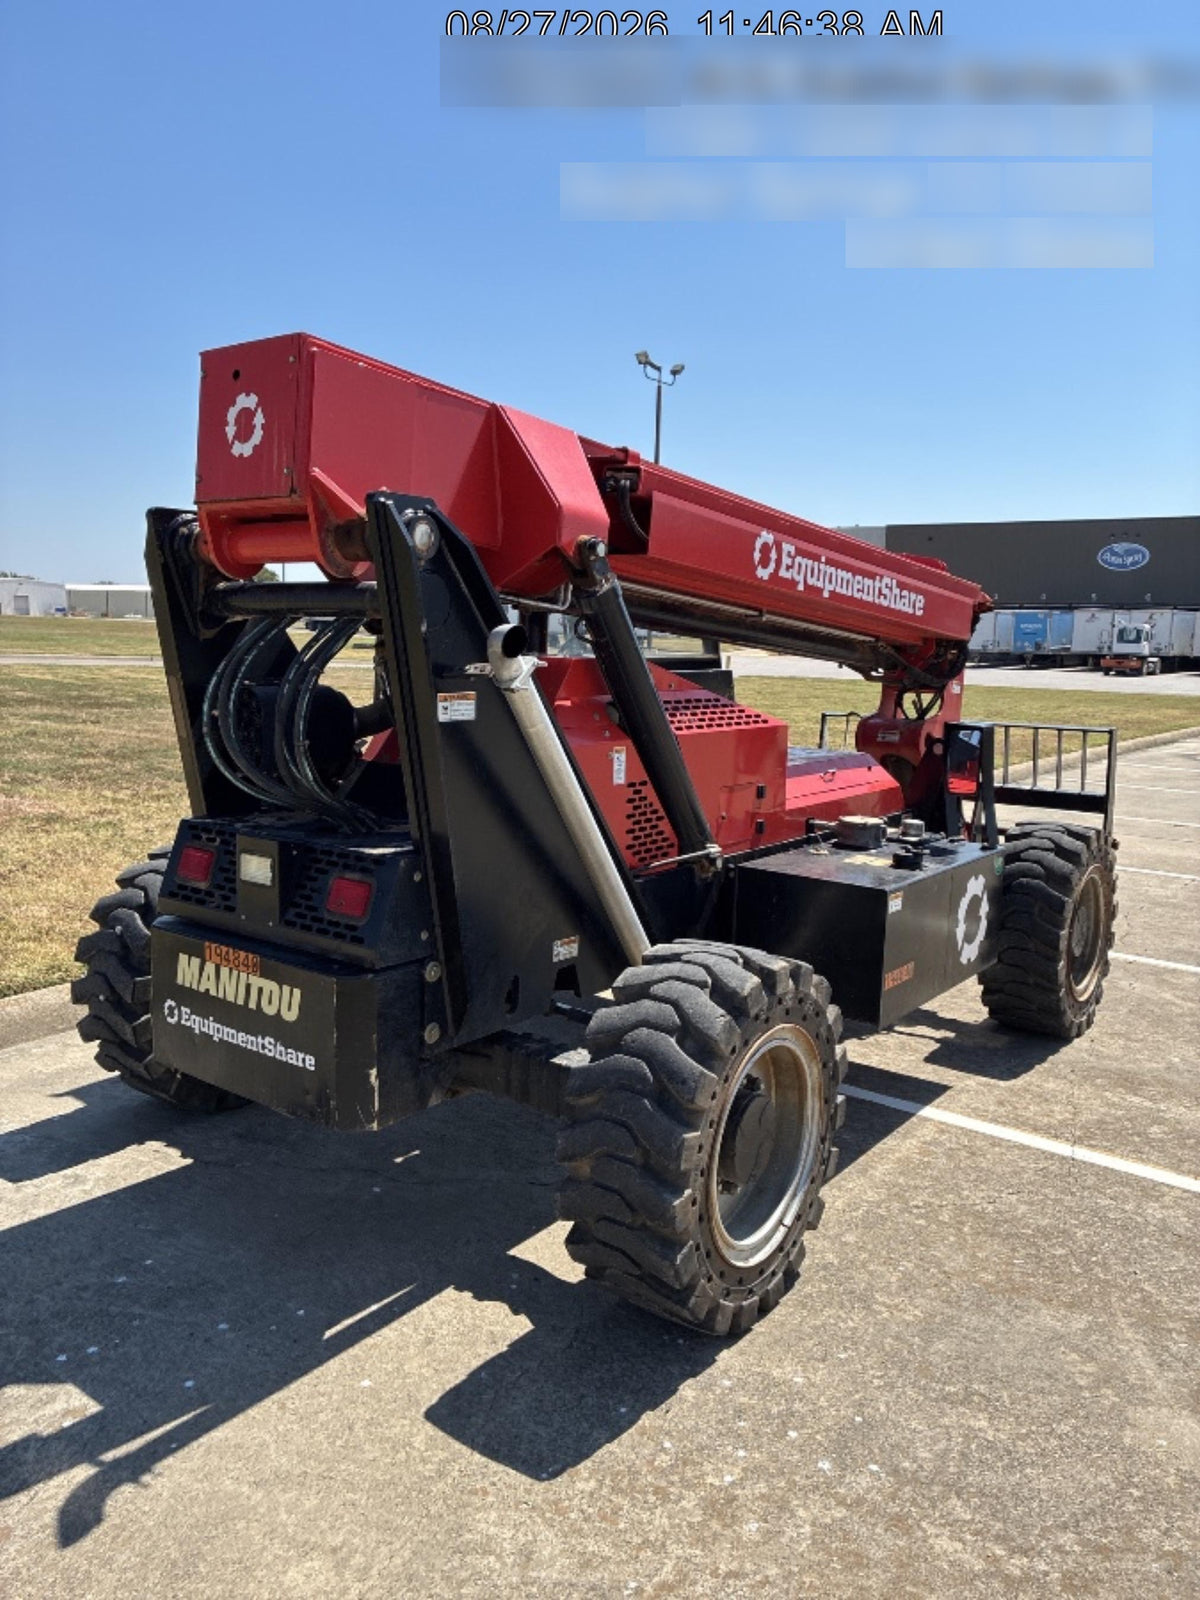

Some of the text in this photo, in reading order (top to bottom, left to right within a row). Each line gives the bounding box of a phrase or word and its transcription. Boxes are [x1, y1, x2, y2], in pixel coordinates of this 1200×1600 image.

[778, 541, 925, 616] EquipmentShare
[176, 952, 301, 1022] MANITOU
[180, 1006, 315, 1071] EquipmentShare
